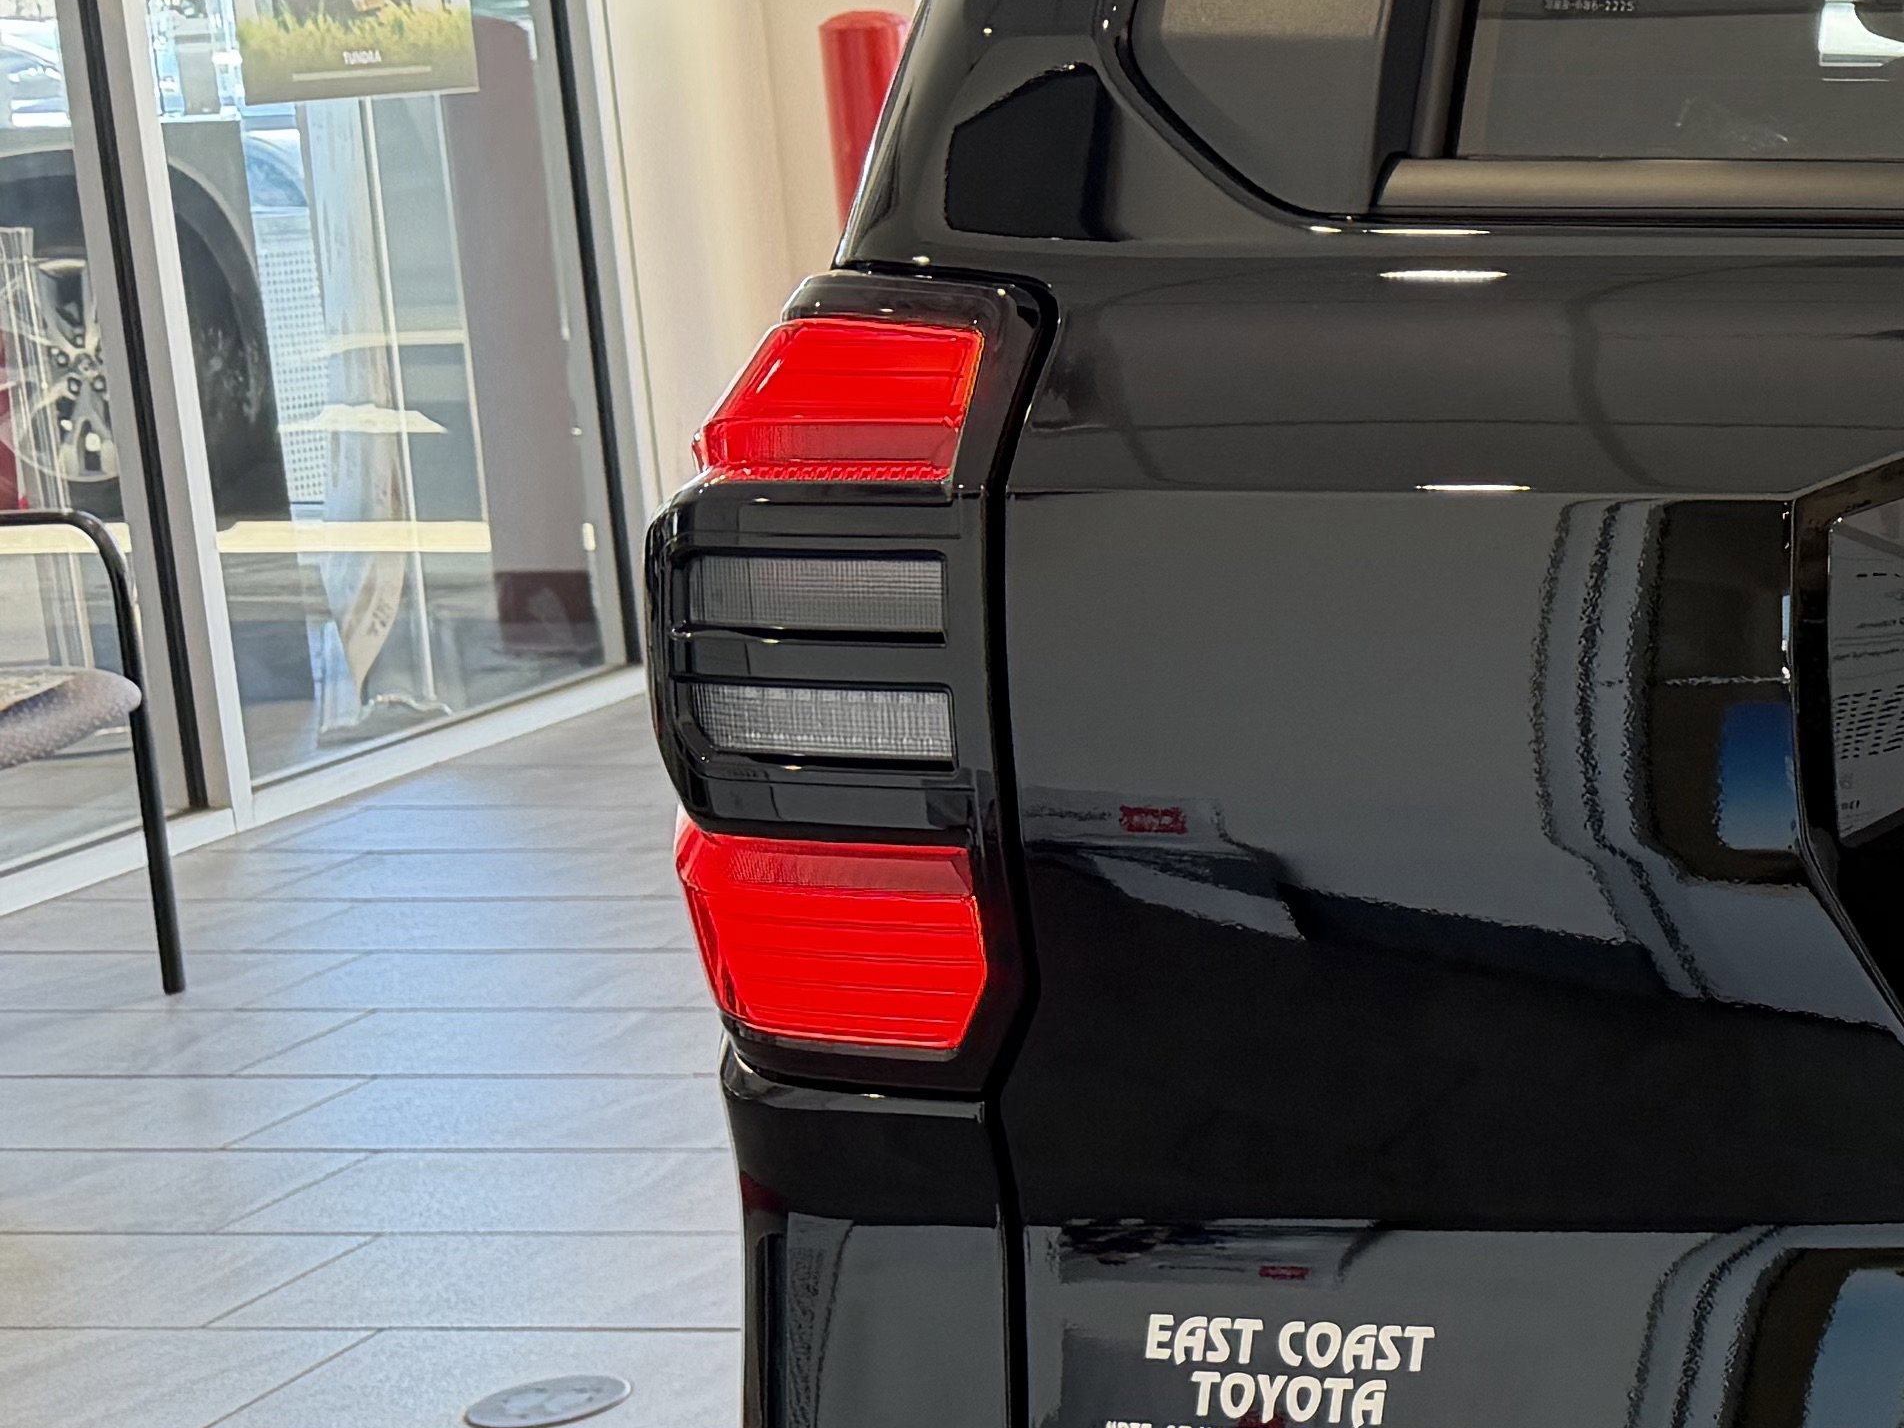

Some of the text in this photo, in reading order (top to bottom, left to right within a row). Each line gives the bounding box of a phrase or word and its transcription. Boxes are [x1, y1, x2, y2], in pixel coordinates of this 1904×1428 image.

[1145, 1314, 1436, 1374] EAST COAST
[1190, 1370, 1387, 1428] TOYOTA
